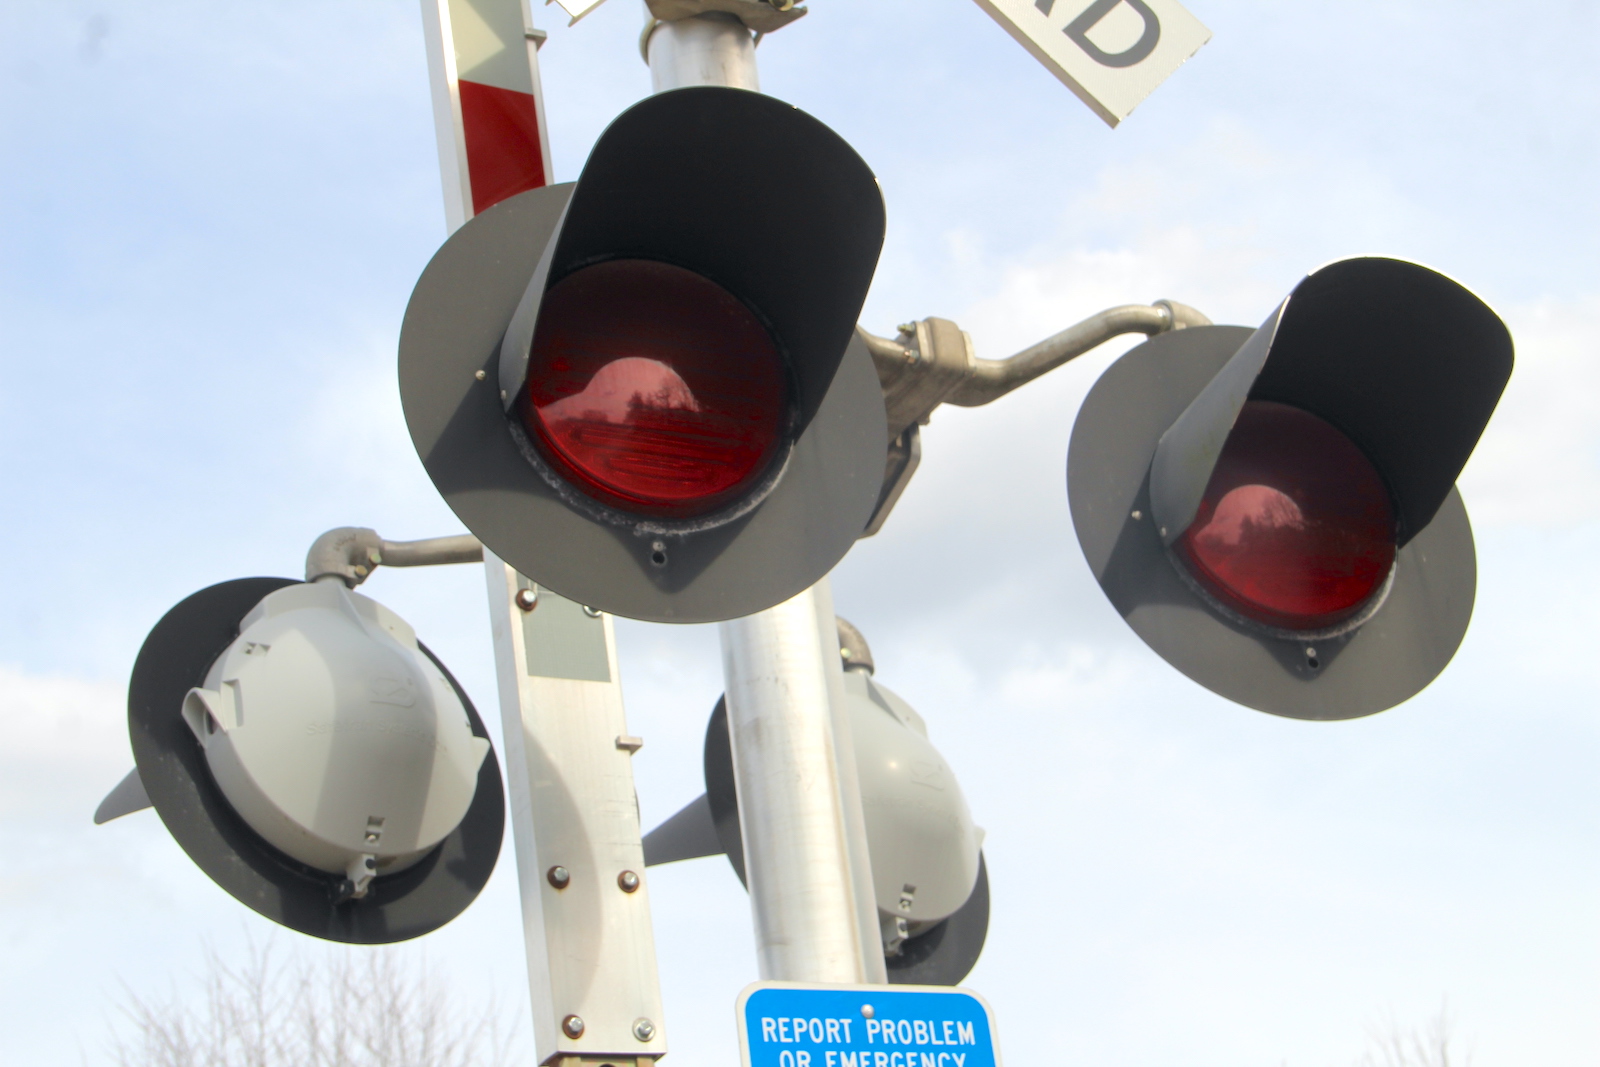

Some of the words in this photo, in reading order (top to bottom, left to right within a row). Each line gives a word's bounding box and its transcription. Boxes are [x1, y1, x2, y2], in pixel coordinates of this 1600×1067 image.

[1034, 0, 1161, 69] D
[761, 1017, 852, 1043] REPORT
[864, 1019, 976, 1045] PROBLEM
[779, 1050, 812, 1067] OR
[825, 1051, 967, 1067] EMERGENCY
